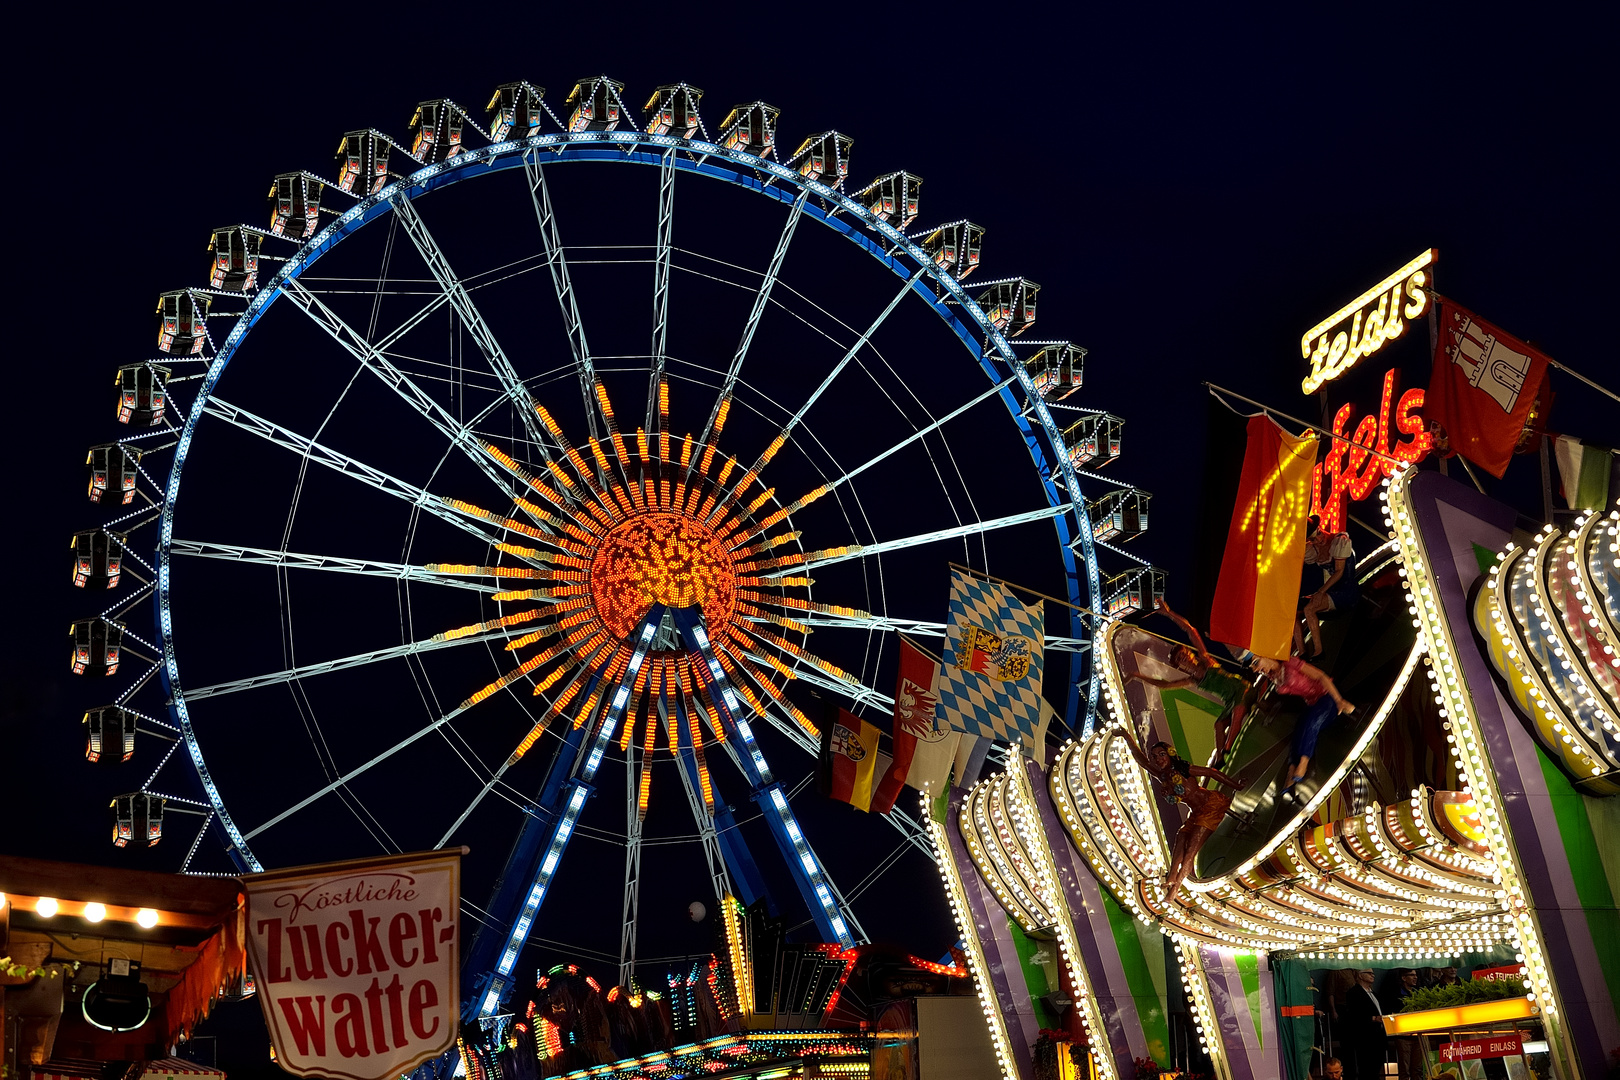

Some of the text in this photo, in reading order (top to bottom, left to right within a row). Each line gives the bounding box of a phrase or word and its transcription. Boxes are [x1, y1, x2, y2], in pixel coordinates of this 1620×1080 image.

[274, 873, 419, 924] Köstliche
[257, 907, 455, 984] Zucker-
[277, 973, 440, 1059] watte
[1490, 1041, 1516, 1053] EINLASS
